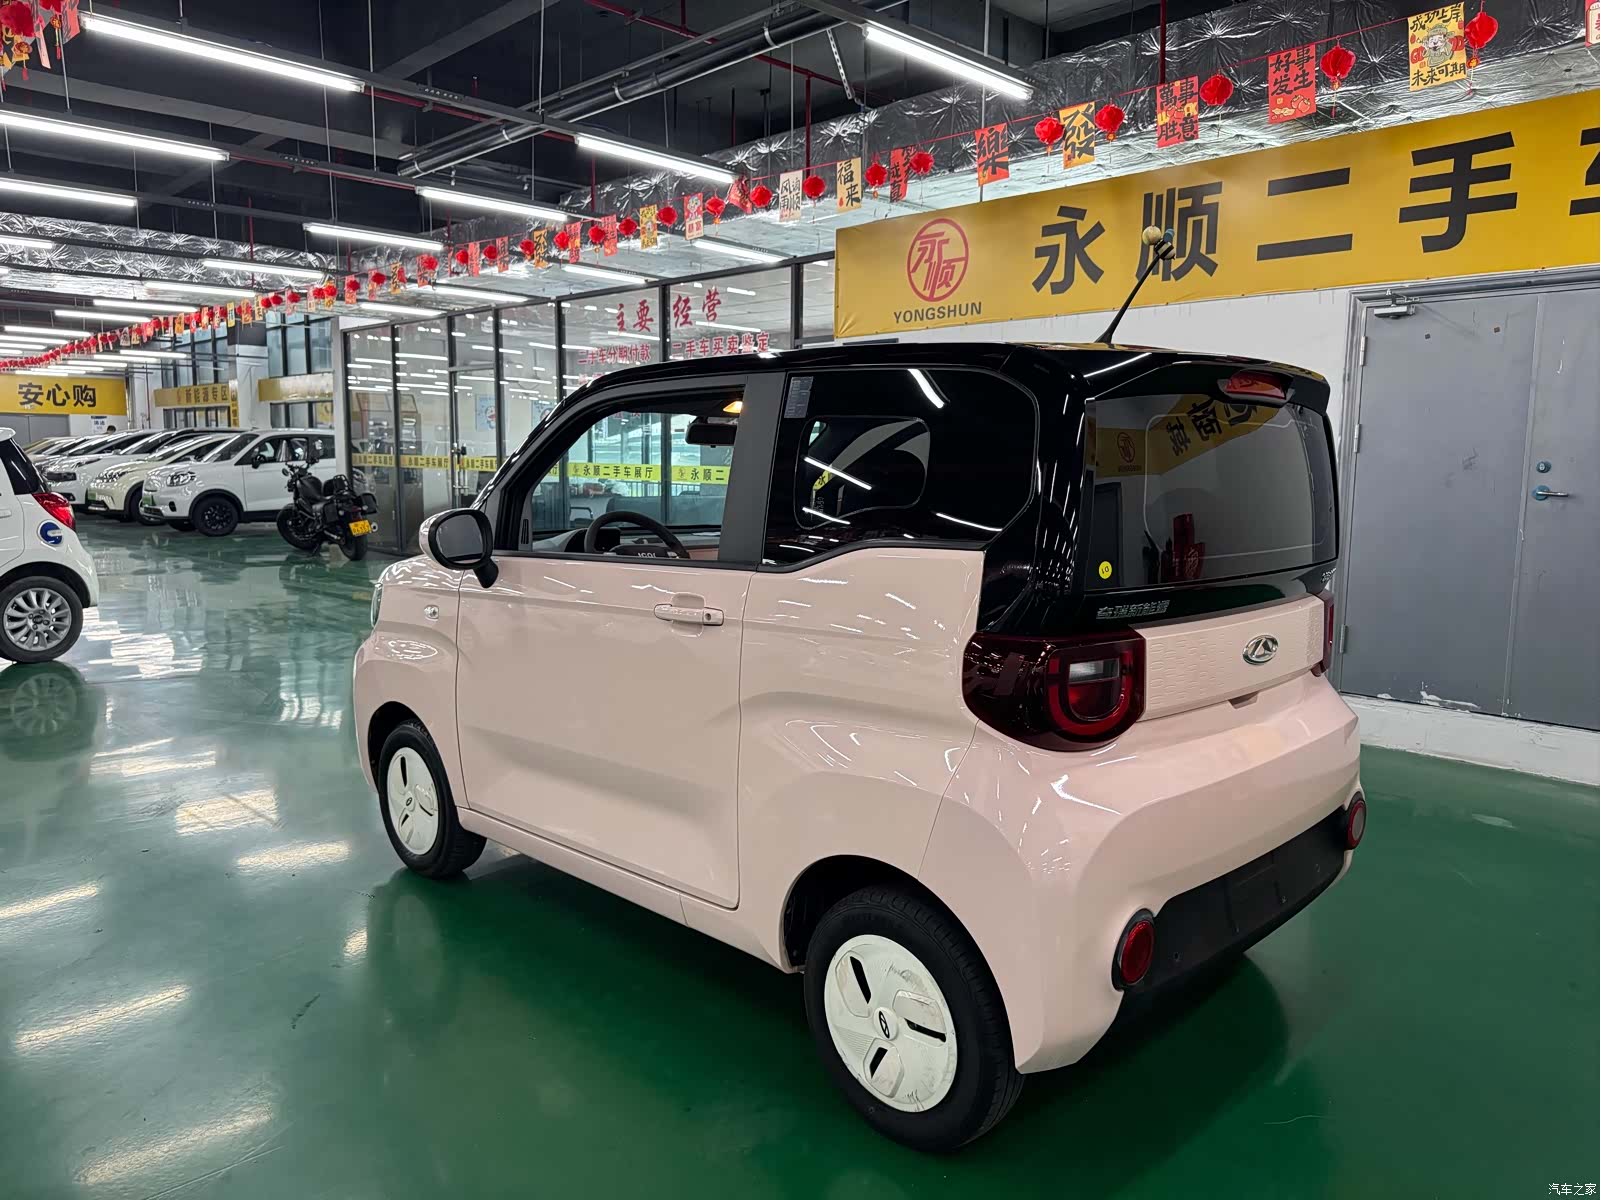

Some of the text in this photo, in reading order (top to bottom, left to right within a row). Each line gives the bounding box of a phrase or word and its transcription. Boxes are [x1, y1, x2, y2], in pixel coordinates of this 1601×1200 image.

[1410, 3, 1462, 32] 成功上岸
[1411, 62, 1467, 86] 未来可期
[893, 301, 982, 324] YONGSHUN
[577, 344, 651, 365] 二手车分期付款
[671, 331, 770, 358] 二手车买卖鉴定
[18, 382, 97, 408] 安心购
[583, 465, 654, 478] 永顺二手车展厅
[690, 468, 725, 481] 永顺二
